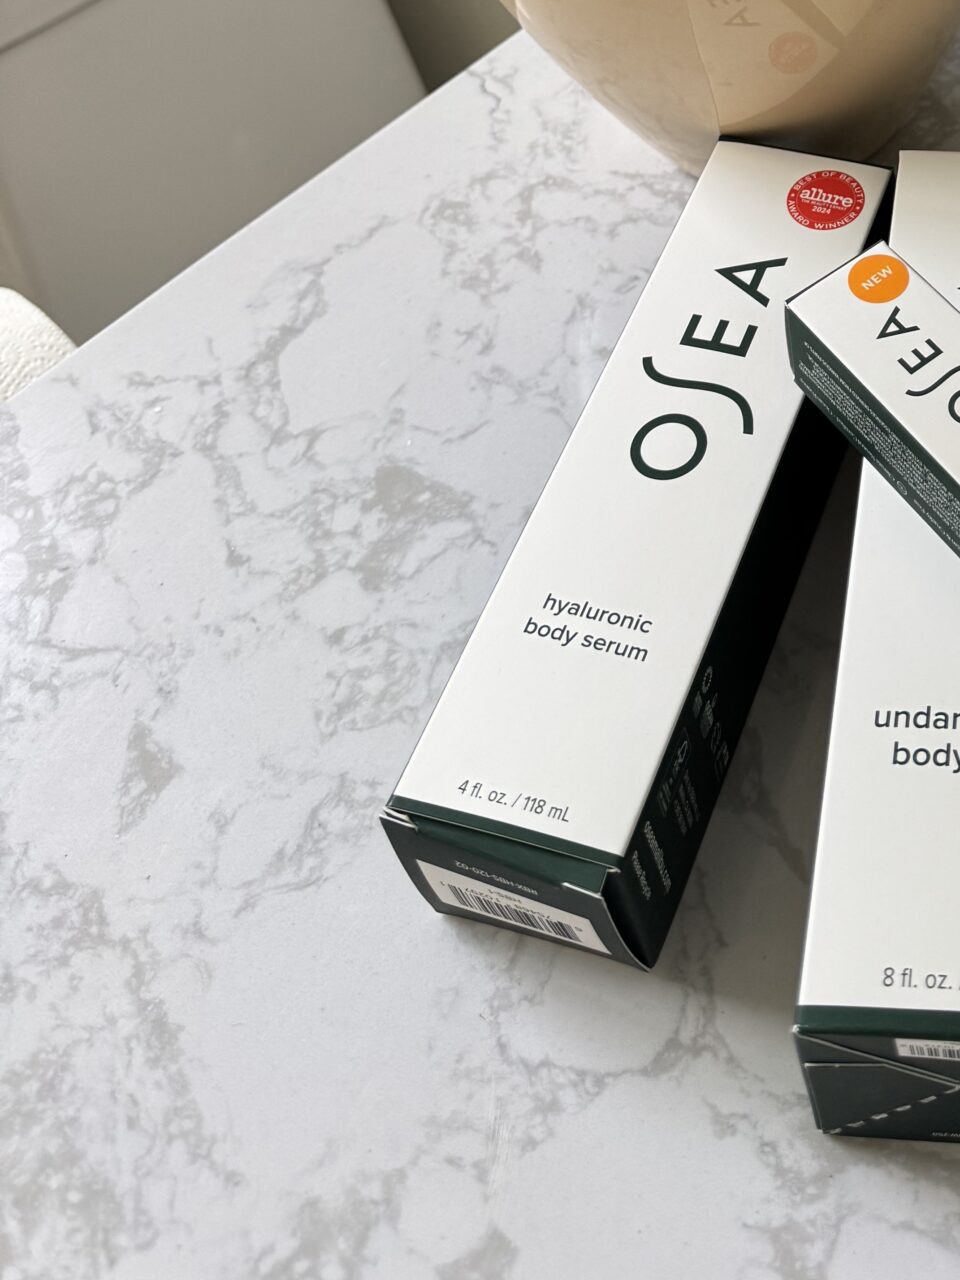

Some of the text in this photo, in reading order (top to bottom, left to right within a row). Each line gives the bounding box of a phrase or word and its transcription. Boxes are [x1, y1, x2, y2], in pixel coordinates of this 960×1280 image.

[793, 173, 817, 191] BEST
[839, 172, 864, 203] BEAUTY
[800, 187, 853, 208] allure
[788, 200, 857, 229] AWARD WINNER
[812, 205, 832, 215] 2024
[861, 265, 893, 291] NEW
[630, 257, 788, 481] OSEA
[543, 593, 653, 633] hyaluronic
[523, 617, 649, 662] body serum
[457, 780, 570, 822] 4 fl. oz. / 118 mL
[882, 967, 895, 988] 8
[900, 968, 918, 988] fl.
[925, 973, 953, 990] oz.
